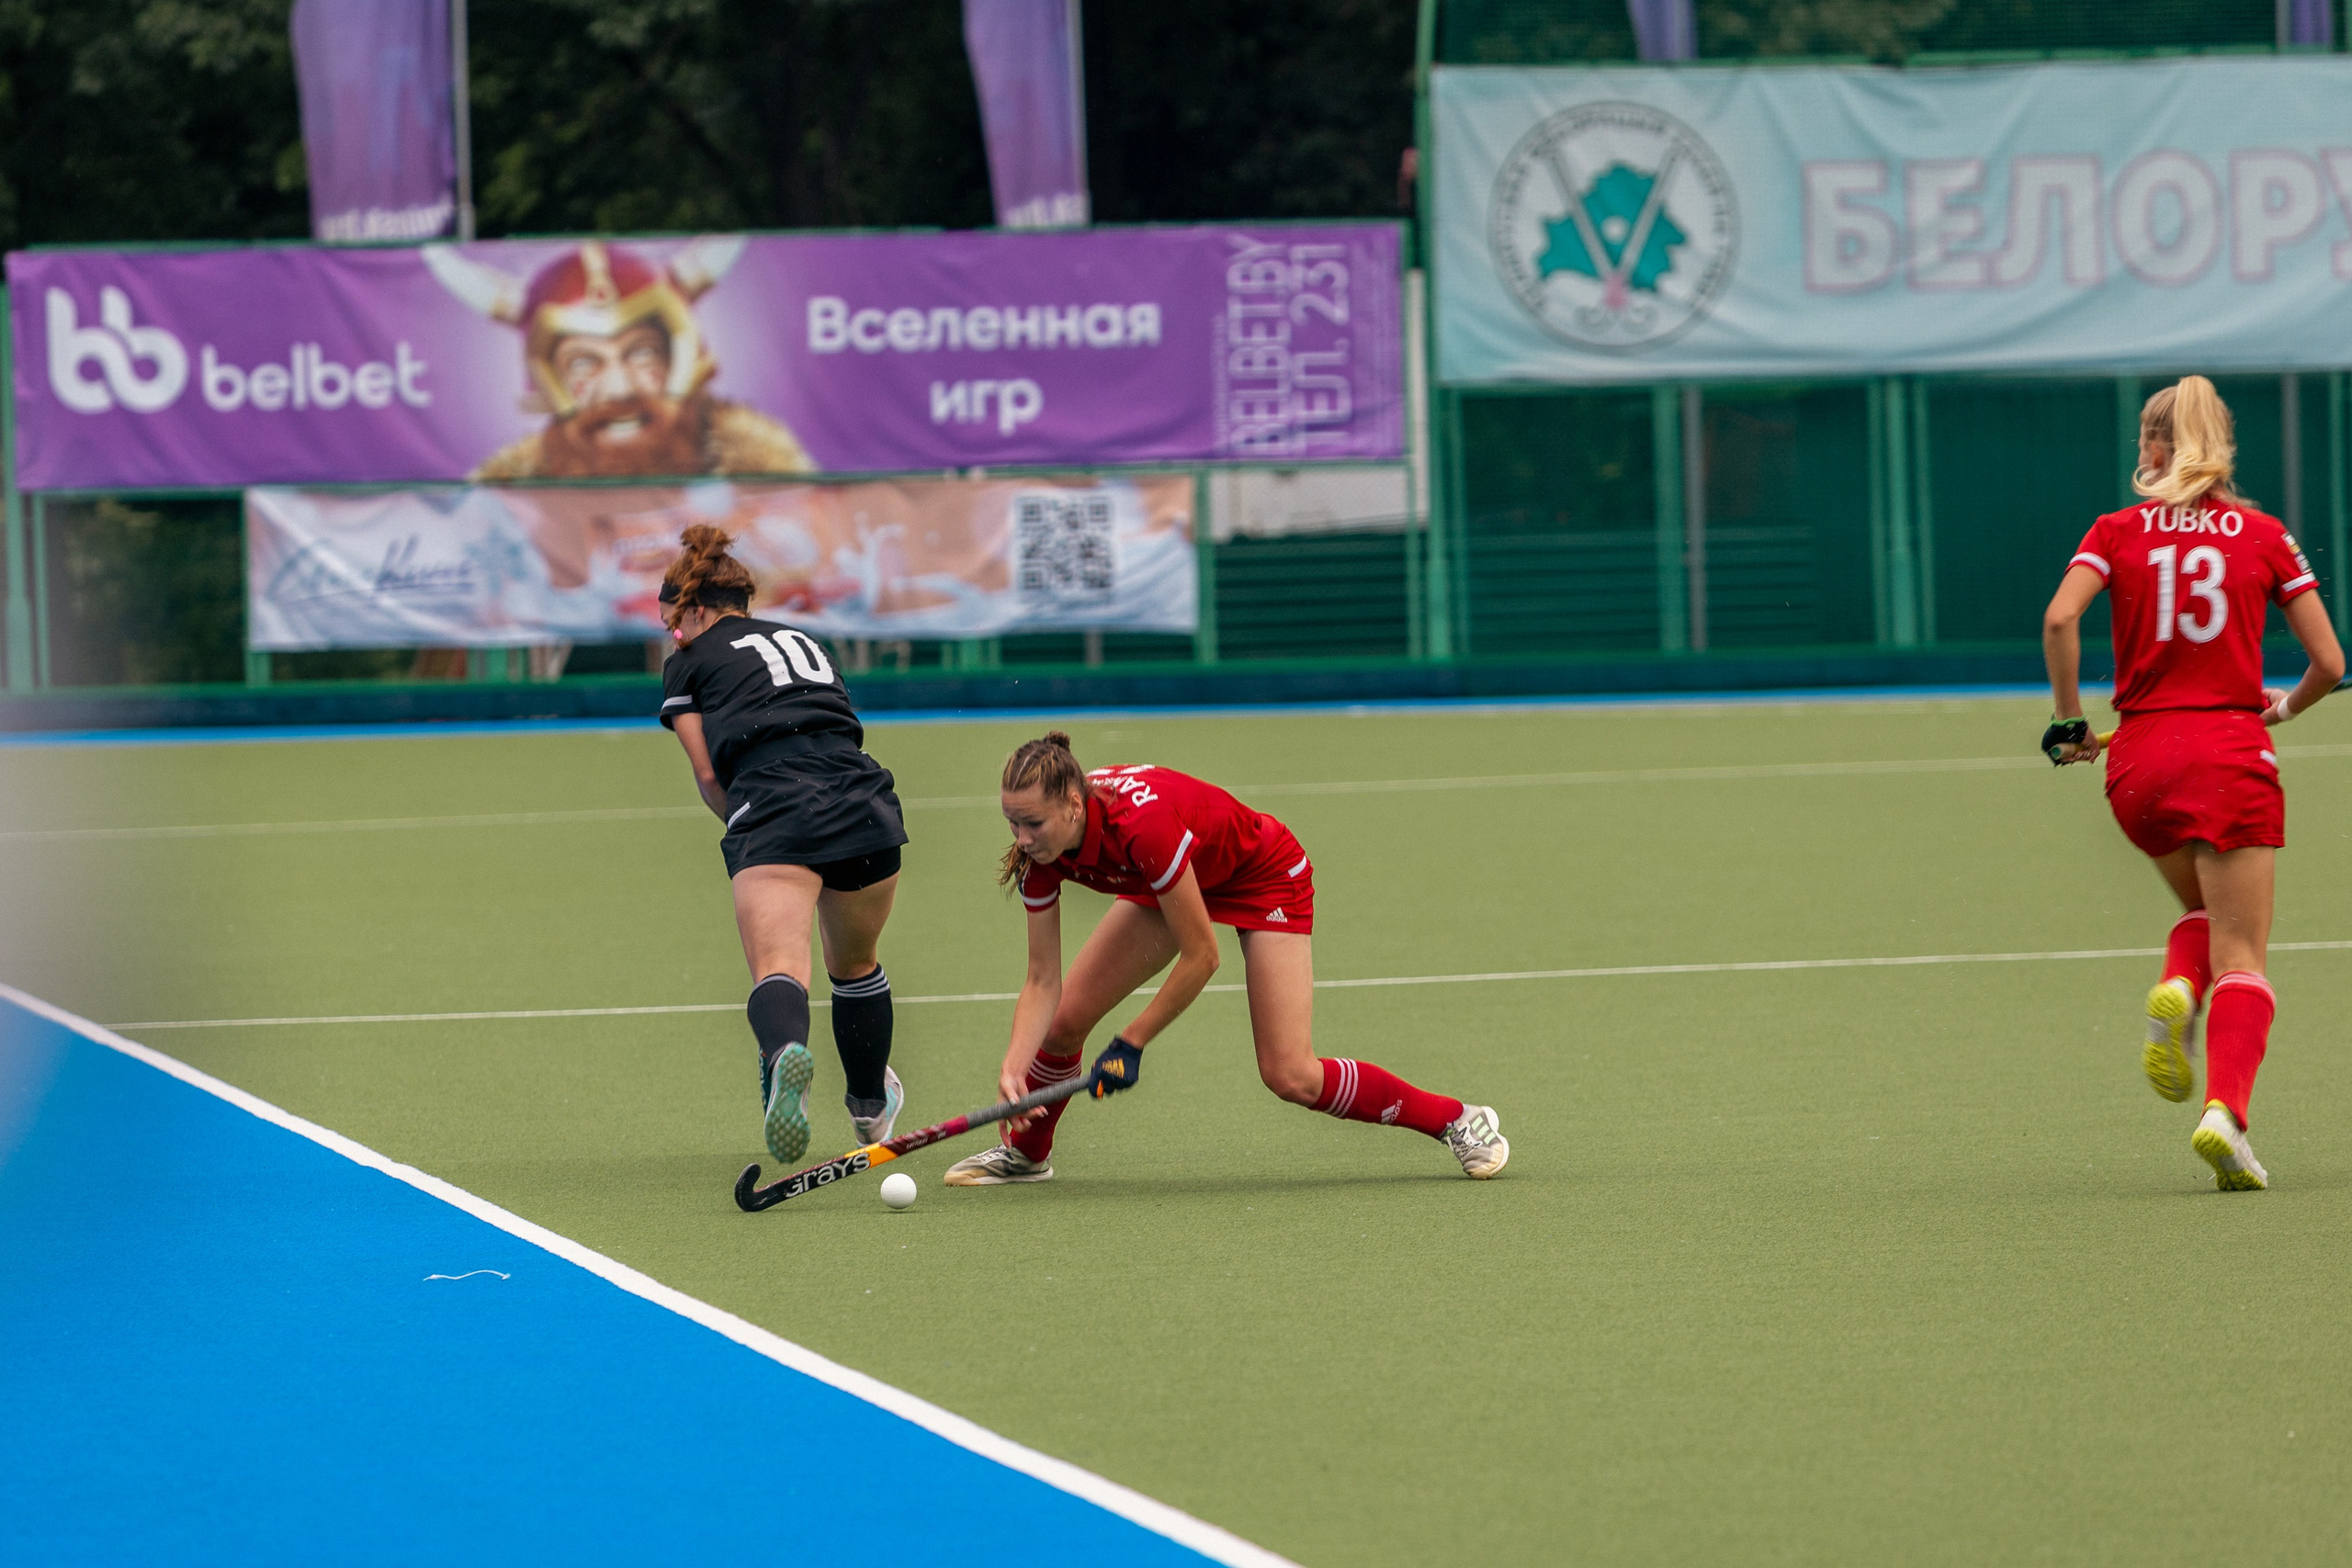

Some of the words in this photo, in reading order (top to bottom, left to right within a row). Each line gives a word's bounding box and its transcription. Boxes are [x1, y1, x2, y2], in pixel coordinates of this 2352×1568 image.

[1289, 243, 1351, 325] 231
[807, 295, 1162, 355] Вселенная
[201, 342, 432, 412] belbet
[930, 378, 1045, 434] игр
[2140, 507, 2244, 537] YUBKO
[2147, 544, 2229, 644] 13
[729, 629, 835, 687] 10
